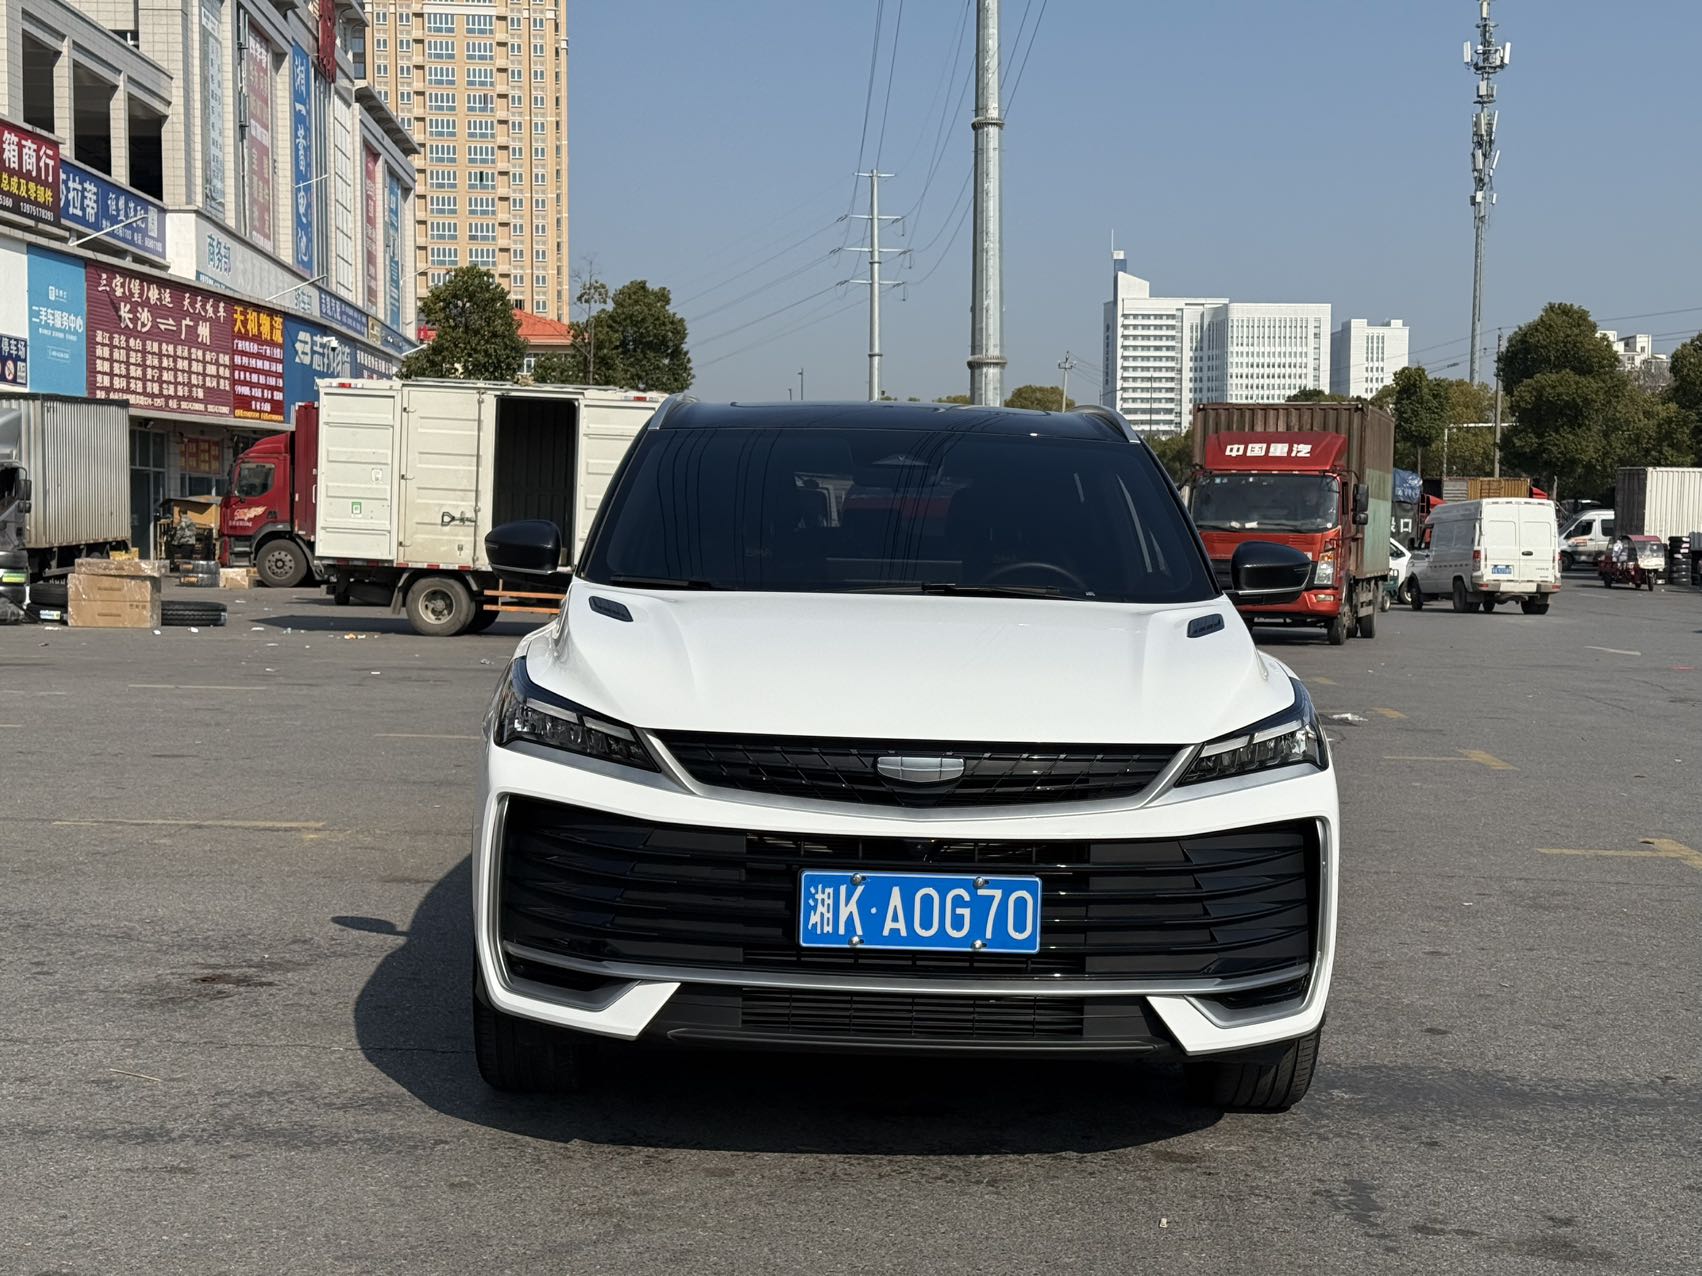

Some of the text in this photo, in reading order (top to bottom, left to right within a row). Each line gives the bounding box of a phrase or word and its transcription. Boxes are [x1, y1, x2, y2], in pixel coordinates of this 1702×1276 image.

[2, 130, 55, 183] 箱商行
[207, 233, 232, 276] 商务部
[31, 305, 84, 333] 二手车服务中心
[119, 302, 211, 346] 长沙 广州
[183, 292, 227, 323] 天天发车
[233, 305, 283, 344] 天和物流
[1, 336, 26, 359] 停车场
[1225, 443, 1312, 457] 中国重汽
